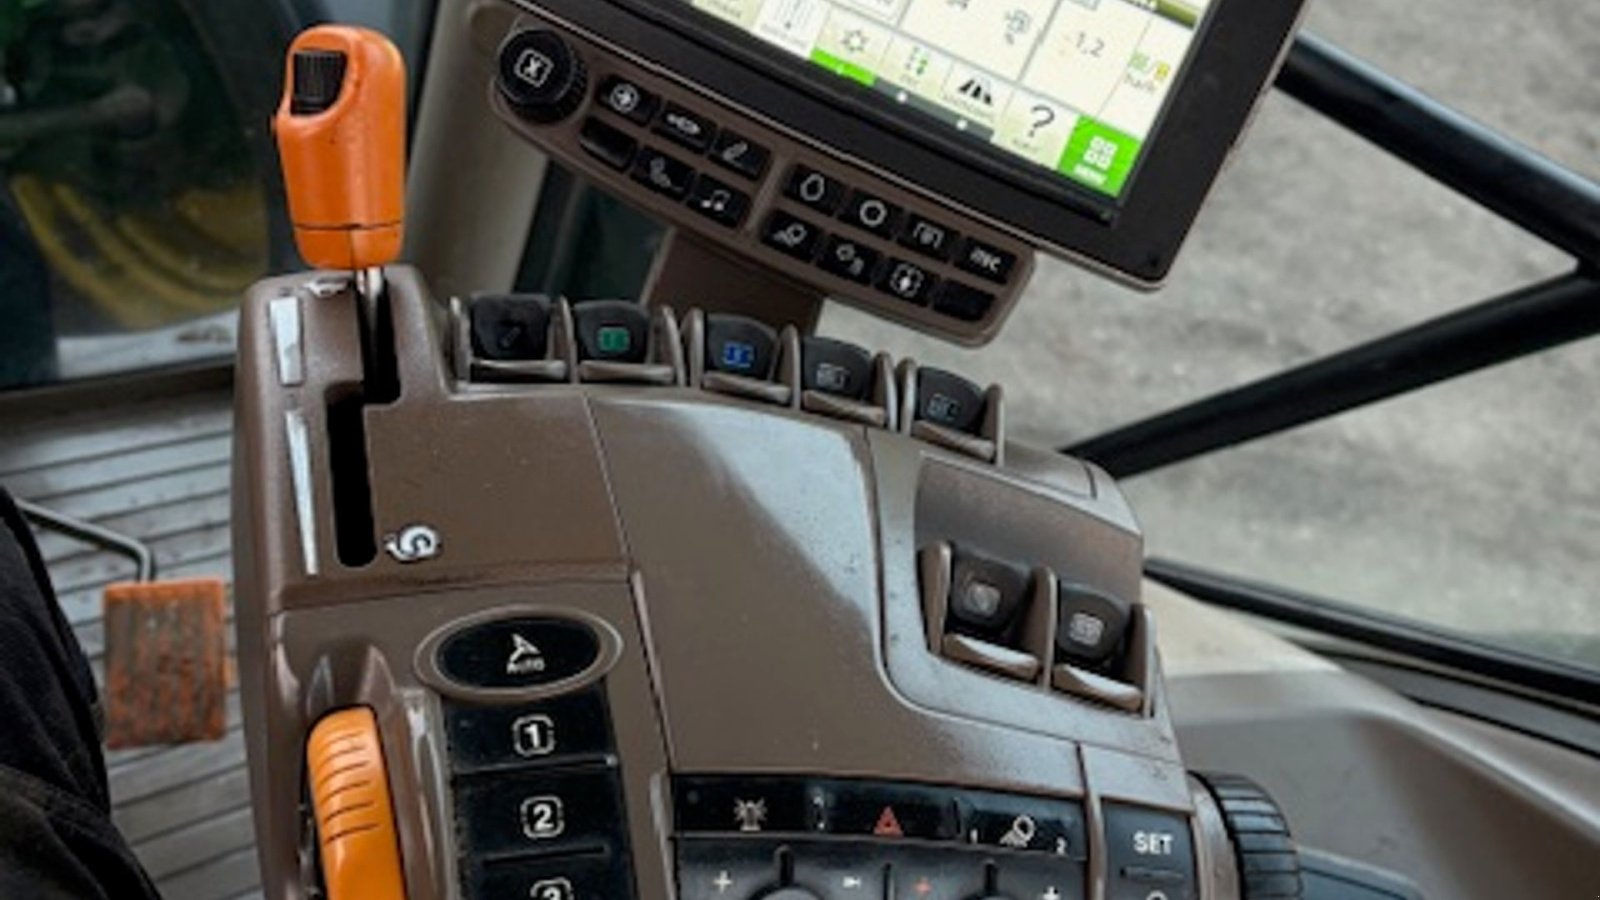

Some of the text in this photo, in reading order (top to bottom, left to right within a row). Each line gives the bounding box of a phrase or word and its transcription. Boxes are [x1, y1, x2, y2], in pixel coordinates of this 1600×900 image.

[524, 724, 540, 748] 1
[533, 805, 553, 831] 2
[1133, 830, 1173, 855] SET
